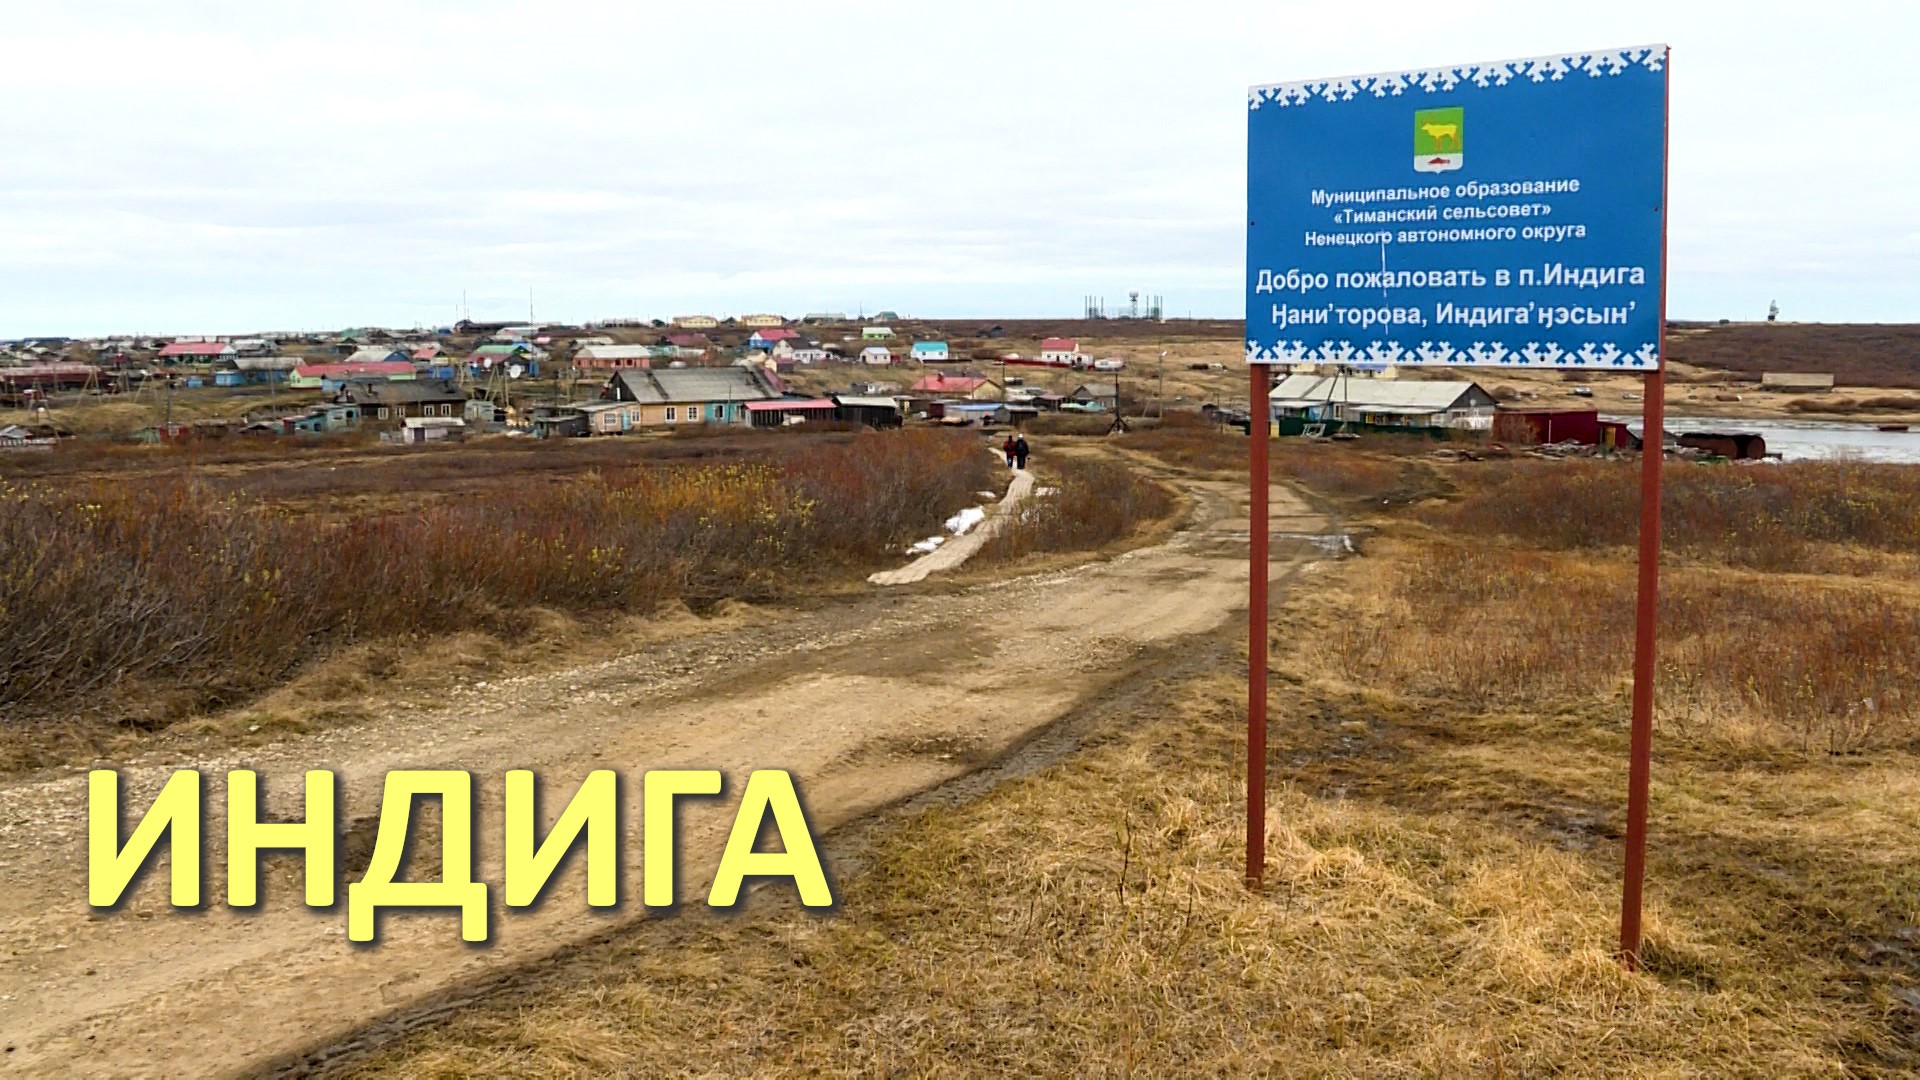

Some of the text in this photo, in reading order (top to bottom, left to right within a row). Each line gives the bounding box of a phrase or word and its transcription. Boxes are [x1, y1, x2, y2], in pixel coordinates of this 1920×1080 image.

[1311, 178, 1580, 206] Муниципальное образование
[1334, 203, 1551, 224] «Тиманский сельсовет»
[1305, 223, 1587, 247] Ненецкого автономного округа
[1255, 262, 1645, 294] Добро пожаловать в п.Индига
